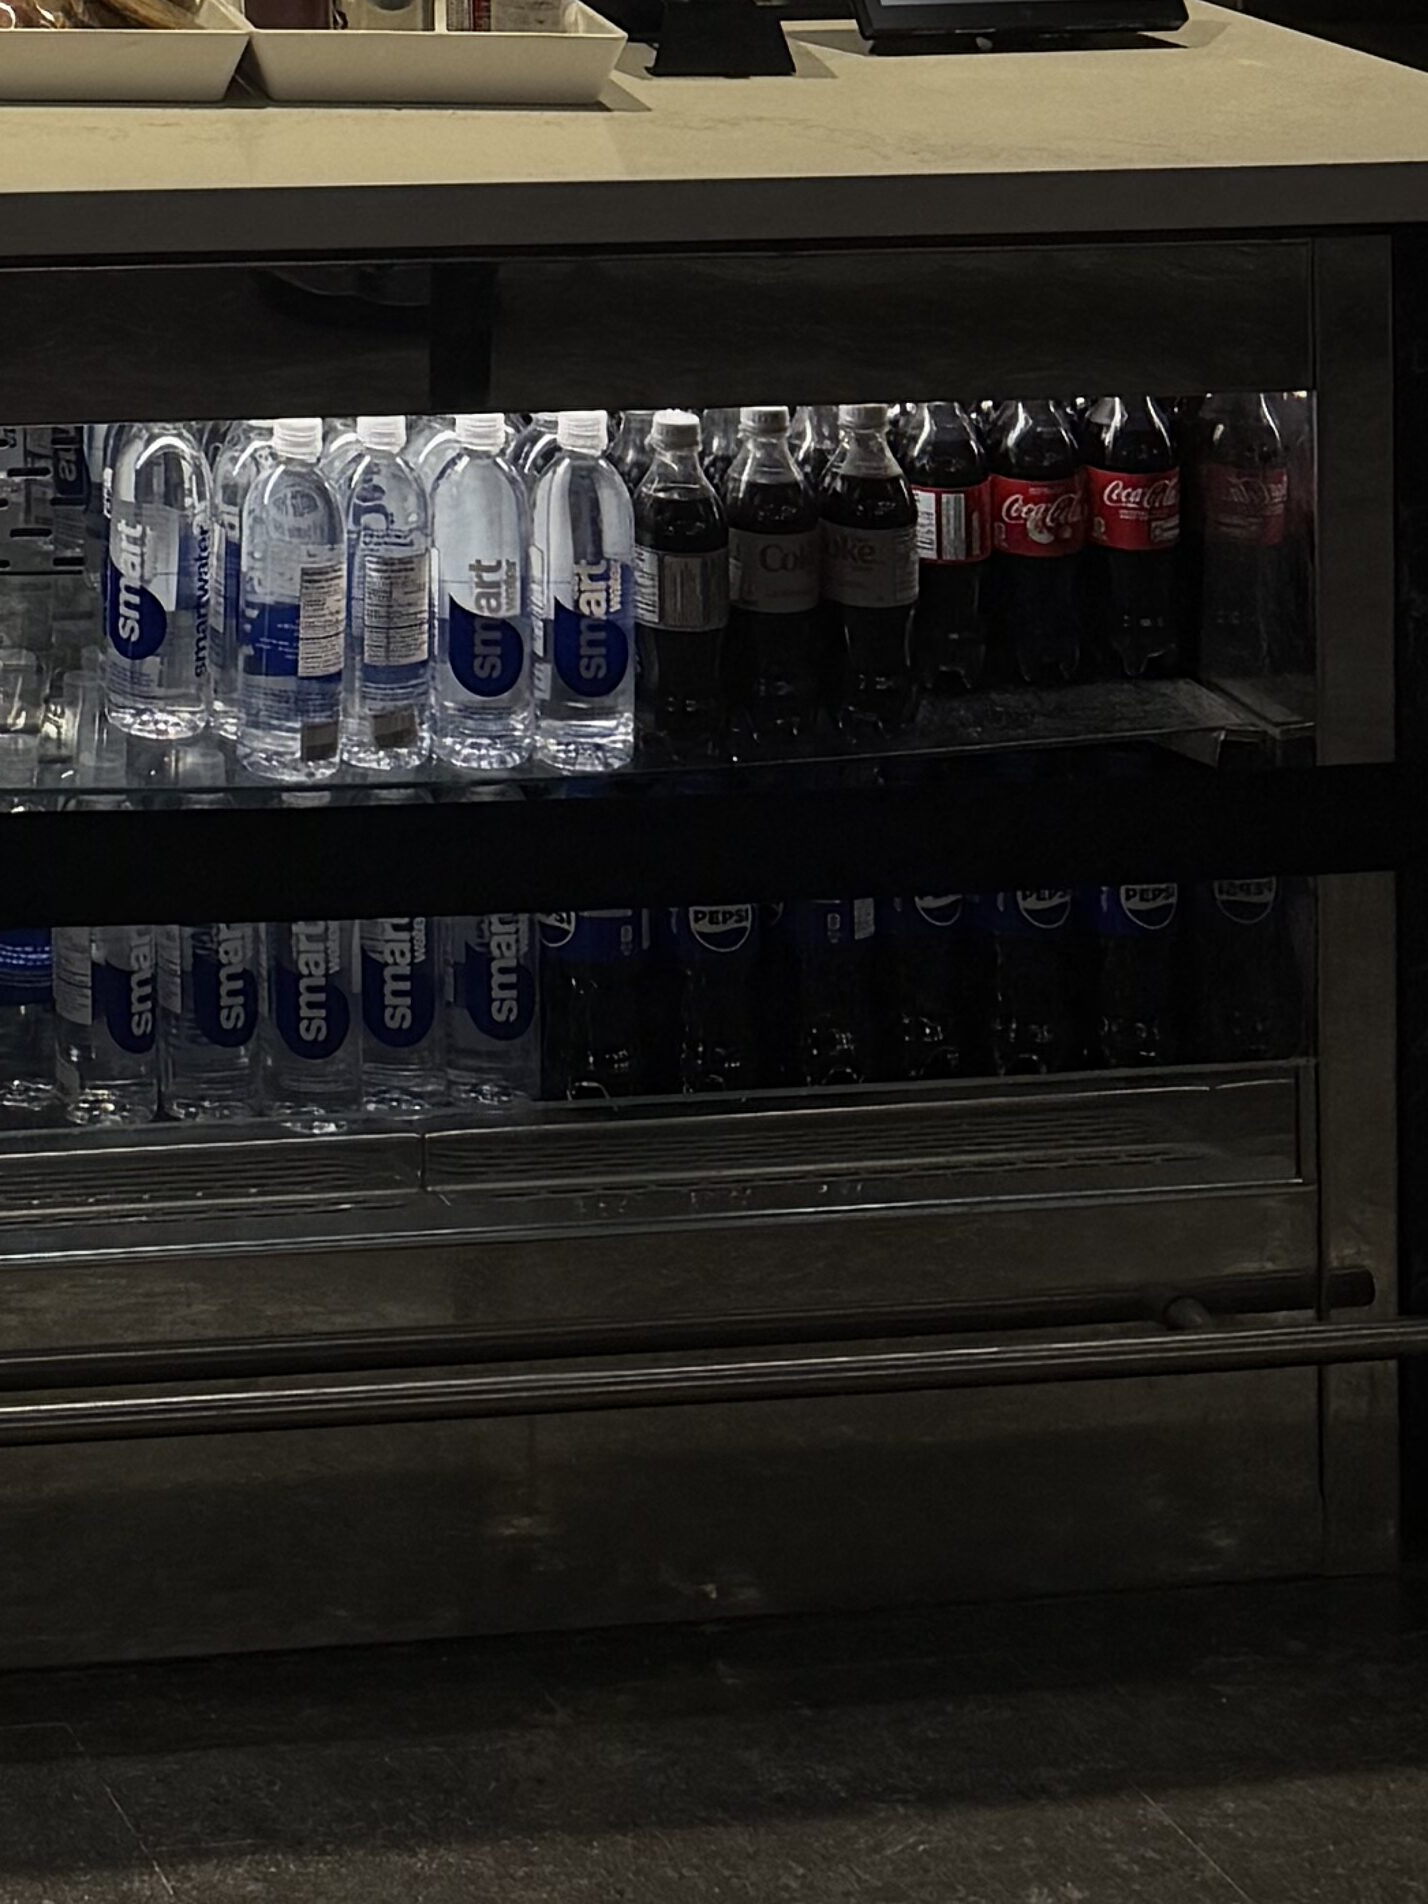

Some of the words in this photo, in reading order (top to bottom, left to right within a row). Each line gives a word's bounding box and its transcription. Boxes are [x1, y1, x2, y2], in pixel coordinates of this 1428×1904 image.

[117, 519, 144, 643] smart
[469, 558, 503, 680] smart
[574, 558, 609, 681] smart
[694, 908, 750, 925] PEPSI
